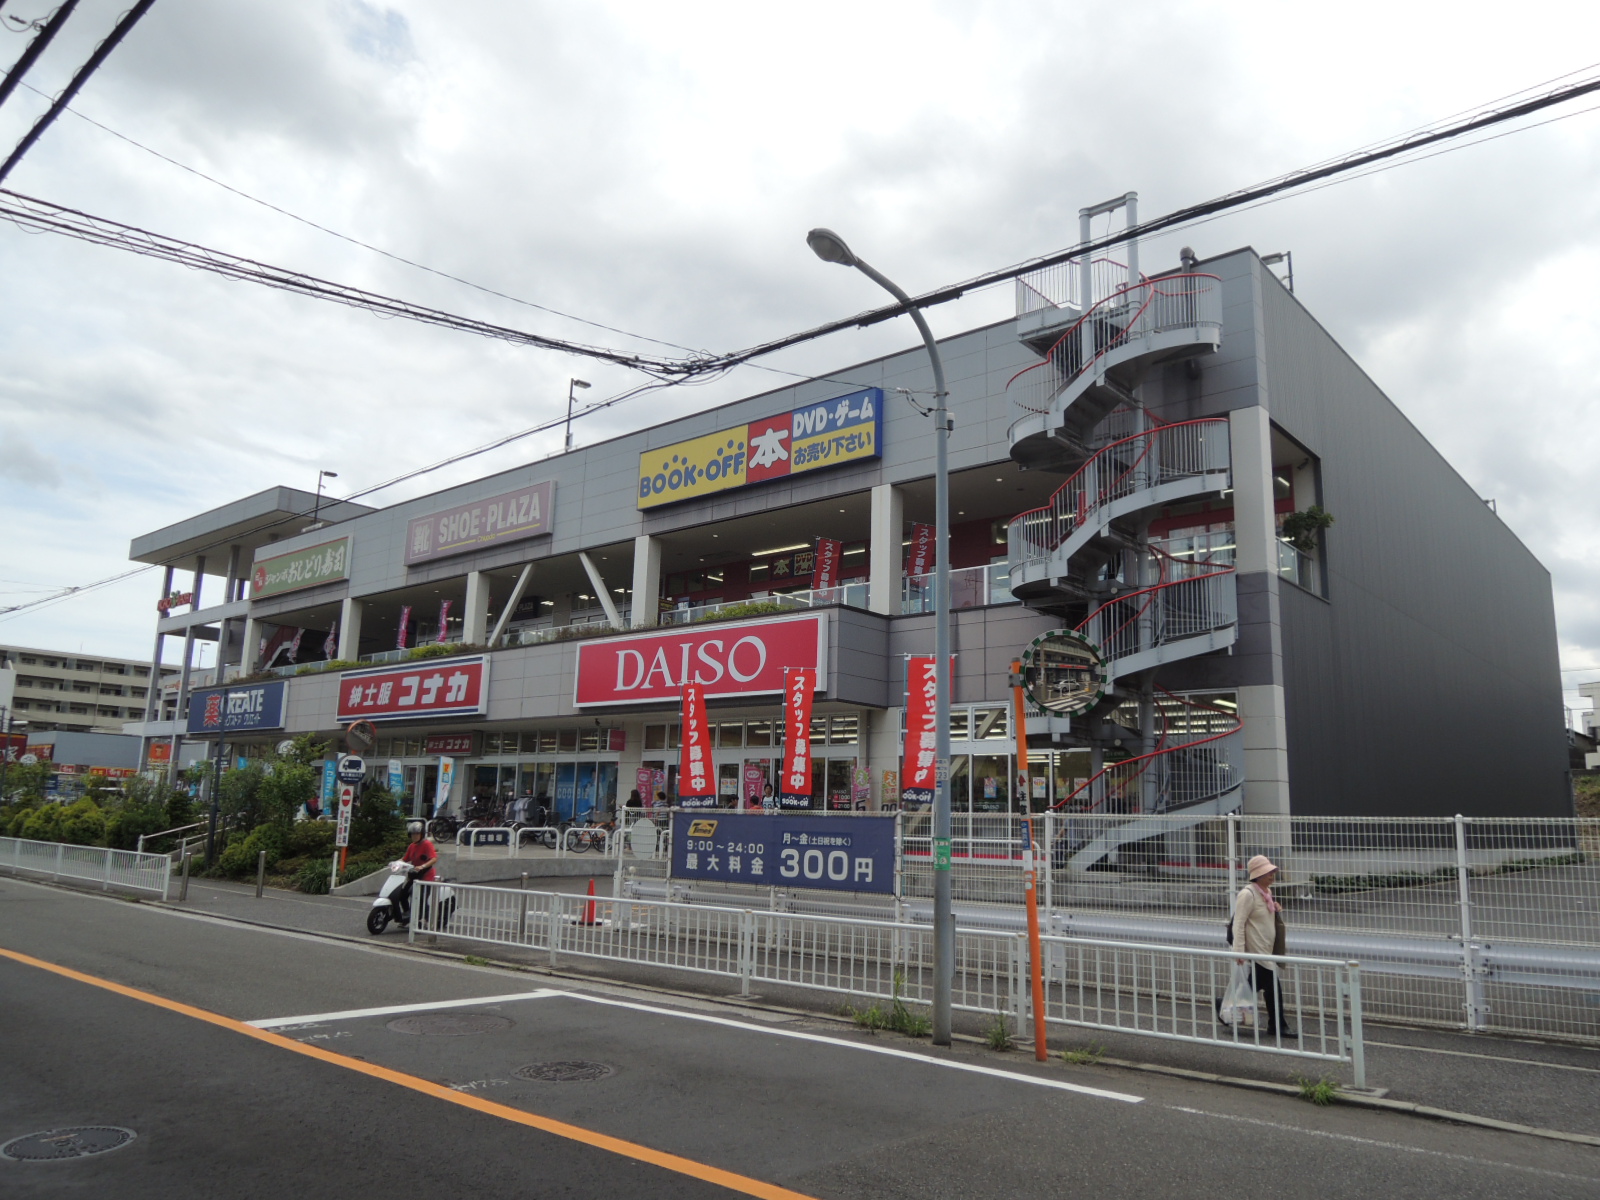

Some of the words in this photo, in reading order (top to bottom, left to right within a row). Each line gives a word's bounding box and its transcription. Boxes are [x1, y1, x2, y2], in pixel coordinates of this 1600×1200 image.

[749, 428, 789, 468] 本
[794, 431, 872, 465] お売り下さい
[773, 560, 790, 575] 本
[795, 552, 813, 563] DVD
[613, 635, 767, 692] DAISO
[348, 682, 394, 707] 紳士服
[398, 671, 469, 706] コナカ
[203, 693, 221, 728] 薬
[446, 738, 470, 749] コナカ
[687, 688, 706, 791] スタッフ募集中
[790, 676, 807, 790] スタッフ募集中
[686, 852, 764, 876] 最大料金
[780, 848, 873, 882] 300円
